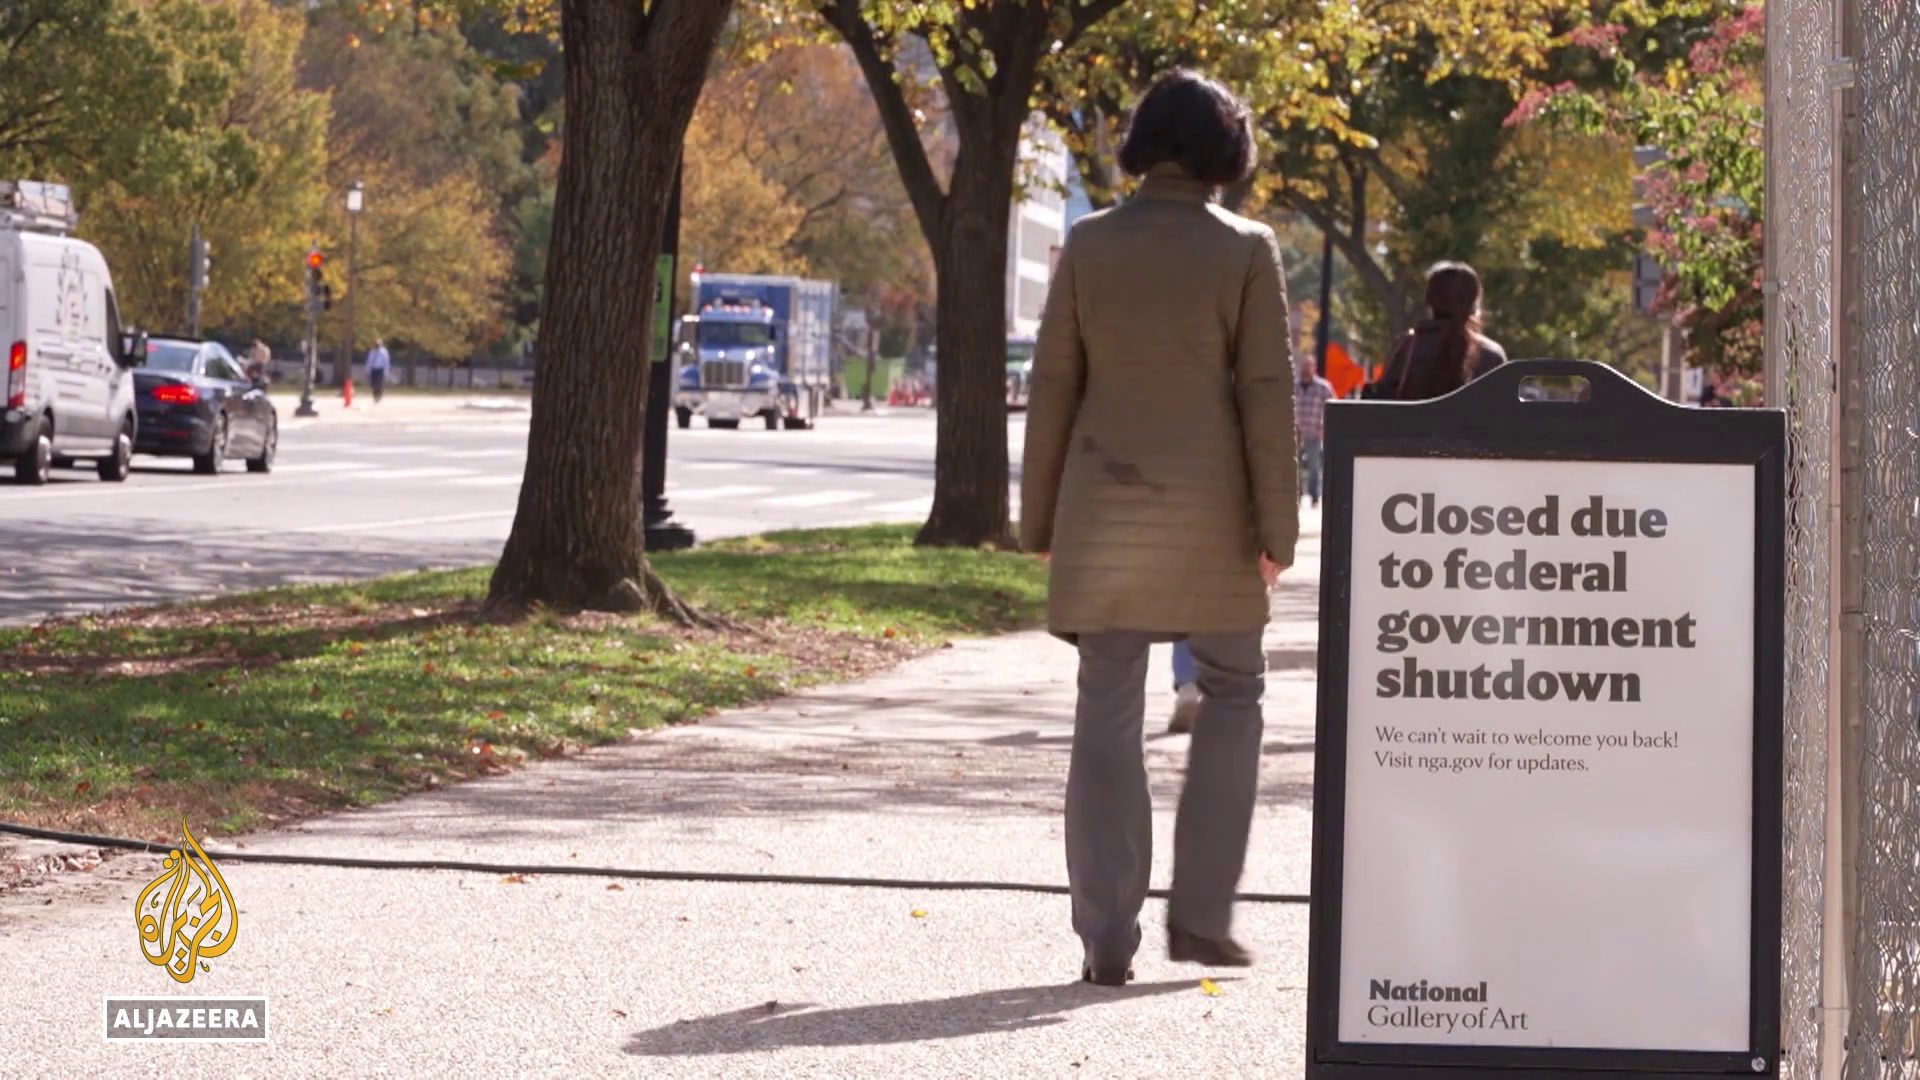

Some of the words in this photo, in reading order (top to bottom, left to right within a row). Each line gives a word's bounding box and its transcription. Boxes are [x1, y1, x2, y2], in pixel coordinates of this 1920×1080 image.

[1381, 493, 1559, 536] Closed
[1570, 495, 1668, 538] due
[1379, 552, 1433, 590] to
[1442, 548, 1627, 592] federal
[1376, 610, 1697, 653] government
[1375, 656, 1642, 703] shutdown
[1375, 725, 1404, 743] We
[1407, 727, 1447, 745] can't
[1451, 728, 1488, 746] wait
[1491, 730, 1510, 746] to
[1513, 728, 1592, 747] welcome
[1596, 734, 1629, 752] you
[1632, 730, 1678, 748] back!
[1374, 750, 1414, 768] Visit
[1418, 755, 1484, 774] nga.gov
[1488, 753, 1513, 770] for
[1516, 754, 1590, 776] updates.
[1369, 978, 1488, 1003] National
[1367, 1004, 1460, 1034] Gallery
[1462, 1007, 1488, 1029] of
[1489, 1007, 1530, 1031] Art
